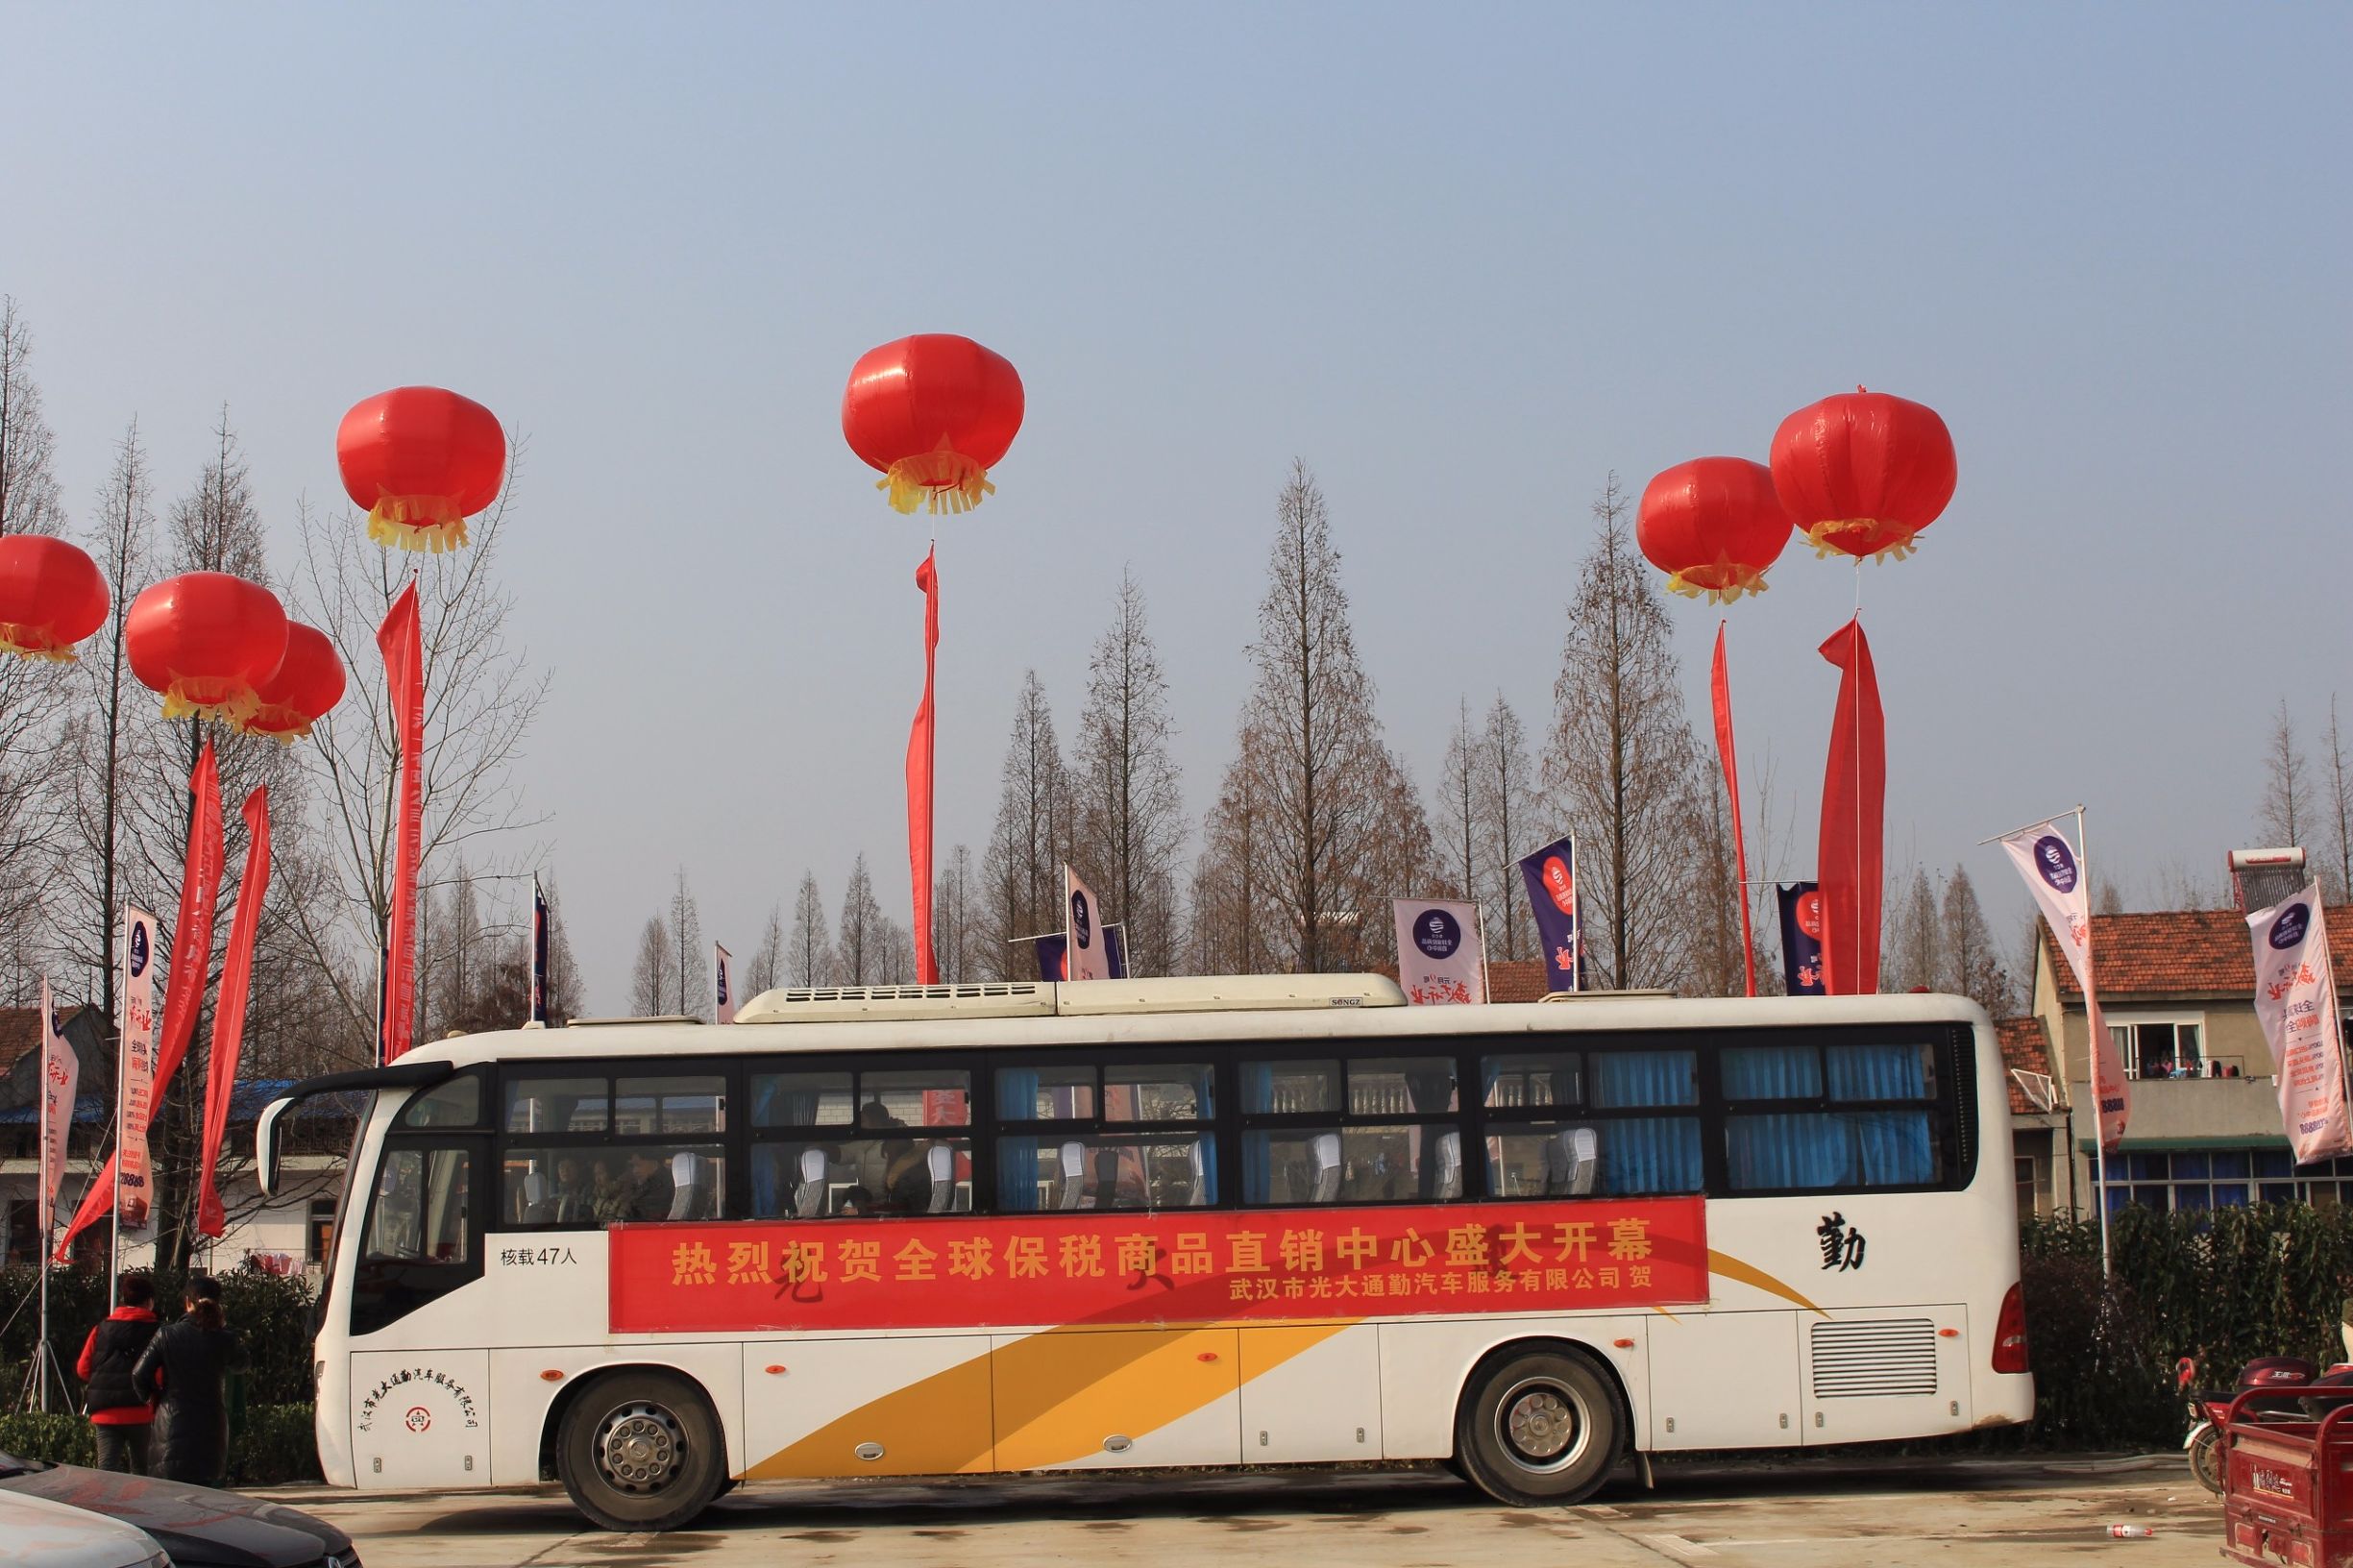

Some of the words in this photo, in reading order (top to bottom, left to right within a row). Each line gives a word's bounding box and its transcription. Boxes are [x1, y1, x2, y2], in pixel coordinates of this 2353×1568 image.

[672, 1218, 1653, 1286] 热烈祝贺全球保税商品直销中心盛大开幕
[1817, 1212, 1866, 1272] 勤
[1229, 1267, 1620, 1301] 武汉市光大通勤汽车服务有限公司
